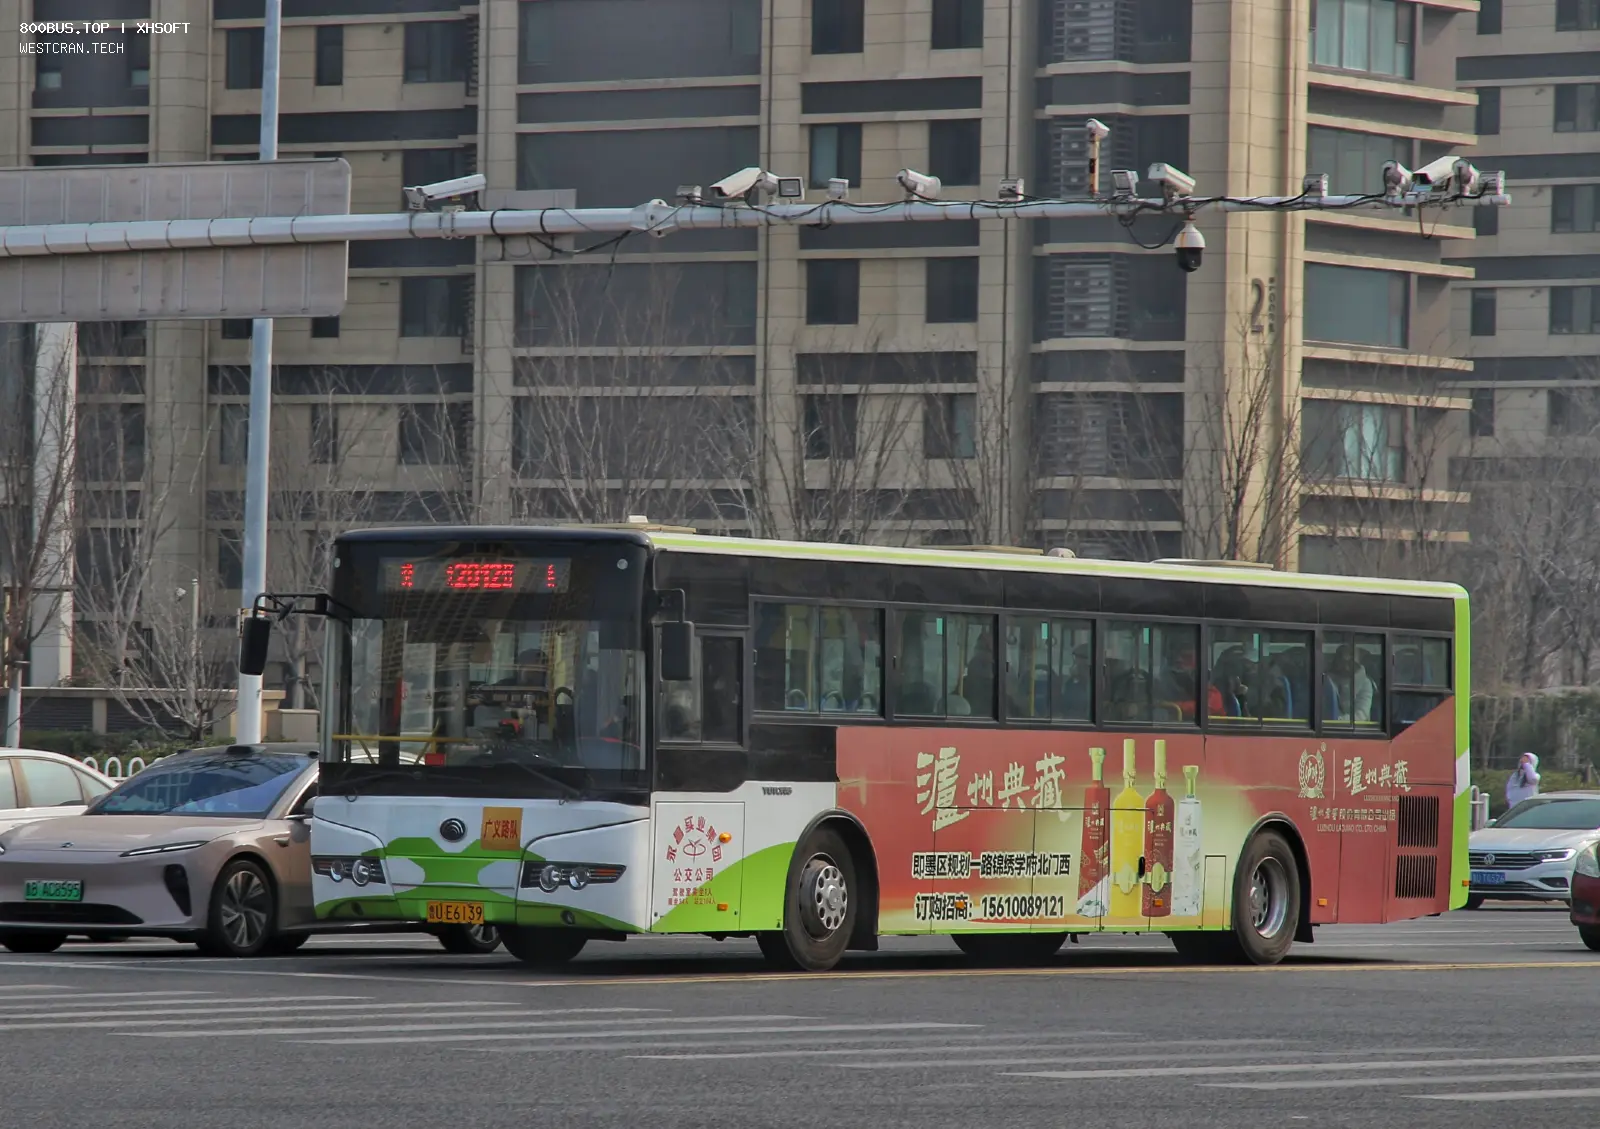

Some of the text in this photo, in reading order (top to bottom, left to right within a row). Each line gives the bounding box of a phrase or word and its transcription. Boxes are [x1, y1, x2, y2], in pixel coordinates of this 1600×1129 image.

[1251, 277, 1265, 333] 2
[916, 746, 1072, 832] 泸州典藏
[1343, 756, 1412, 796] 泸州典藏
[673, 867, 714, 882] 公交公司
[912, 853, 1071, 877] 即墨区规划一路锦绣学府北门西
[981, 895, 1065, 917] 15610089121
